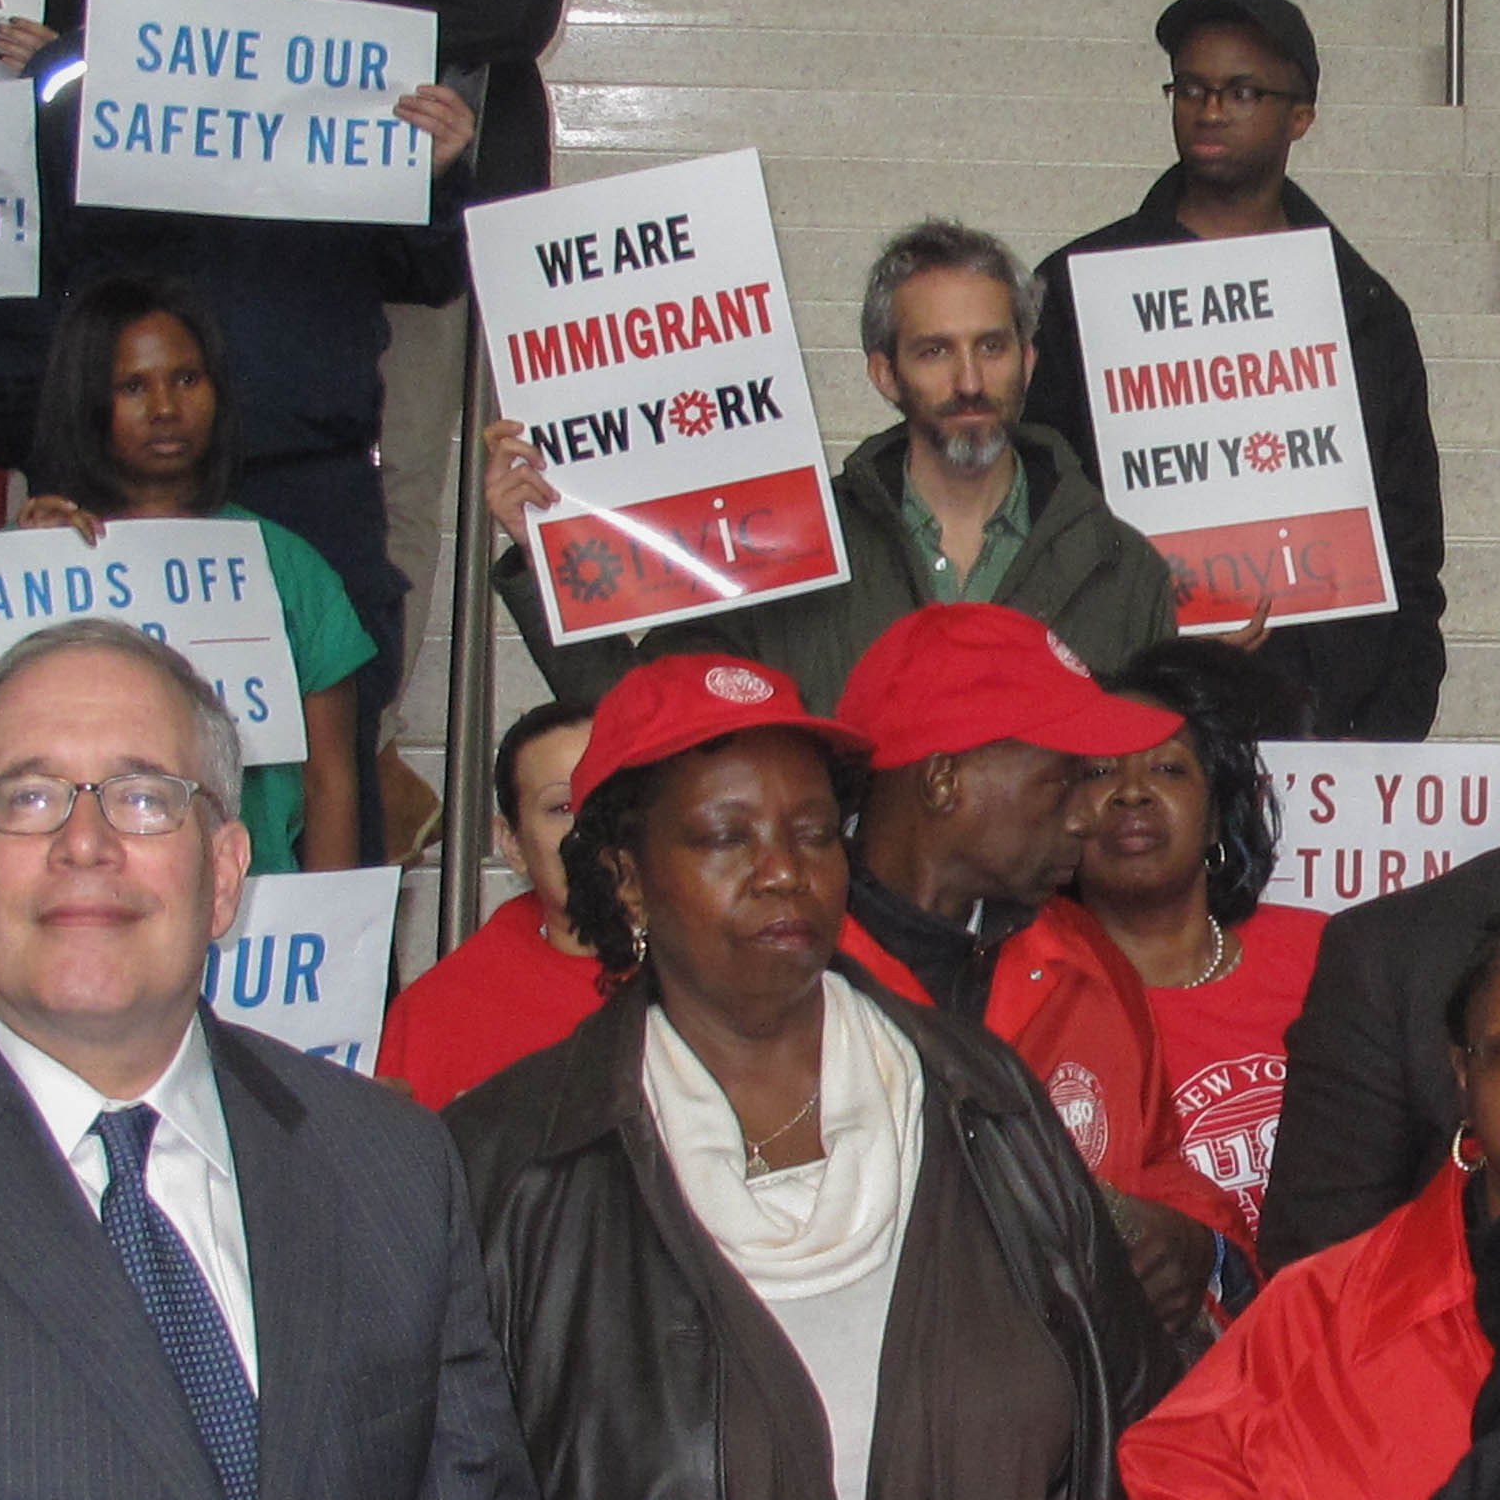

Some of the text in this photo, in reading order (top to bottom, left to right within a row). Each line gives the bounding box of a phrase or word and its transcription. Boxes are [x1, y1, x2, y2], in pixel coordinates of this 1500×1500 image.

[136, 22, 388, 91] SAVE OUR
[93, 100, 419, 167] SAFETY NET!
[534, 213, 696, 288] WE ARE
[507, 282, 774, 385] IMMIGRANT
[1132, 279, 1274, 333] WE ARE
[1104, 342, 1338, 414] IMMIGRANT
[529, 407, 630, 466] NEW
[1122, 441, 1210, 491] NEW
[164, 557, 248, 604] OFF
